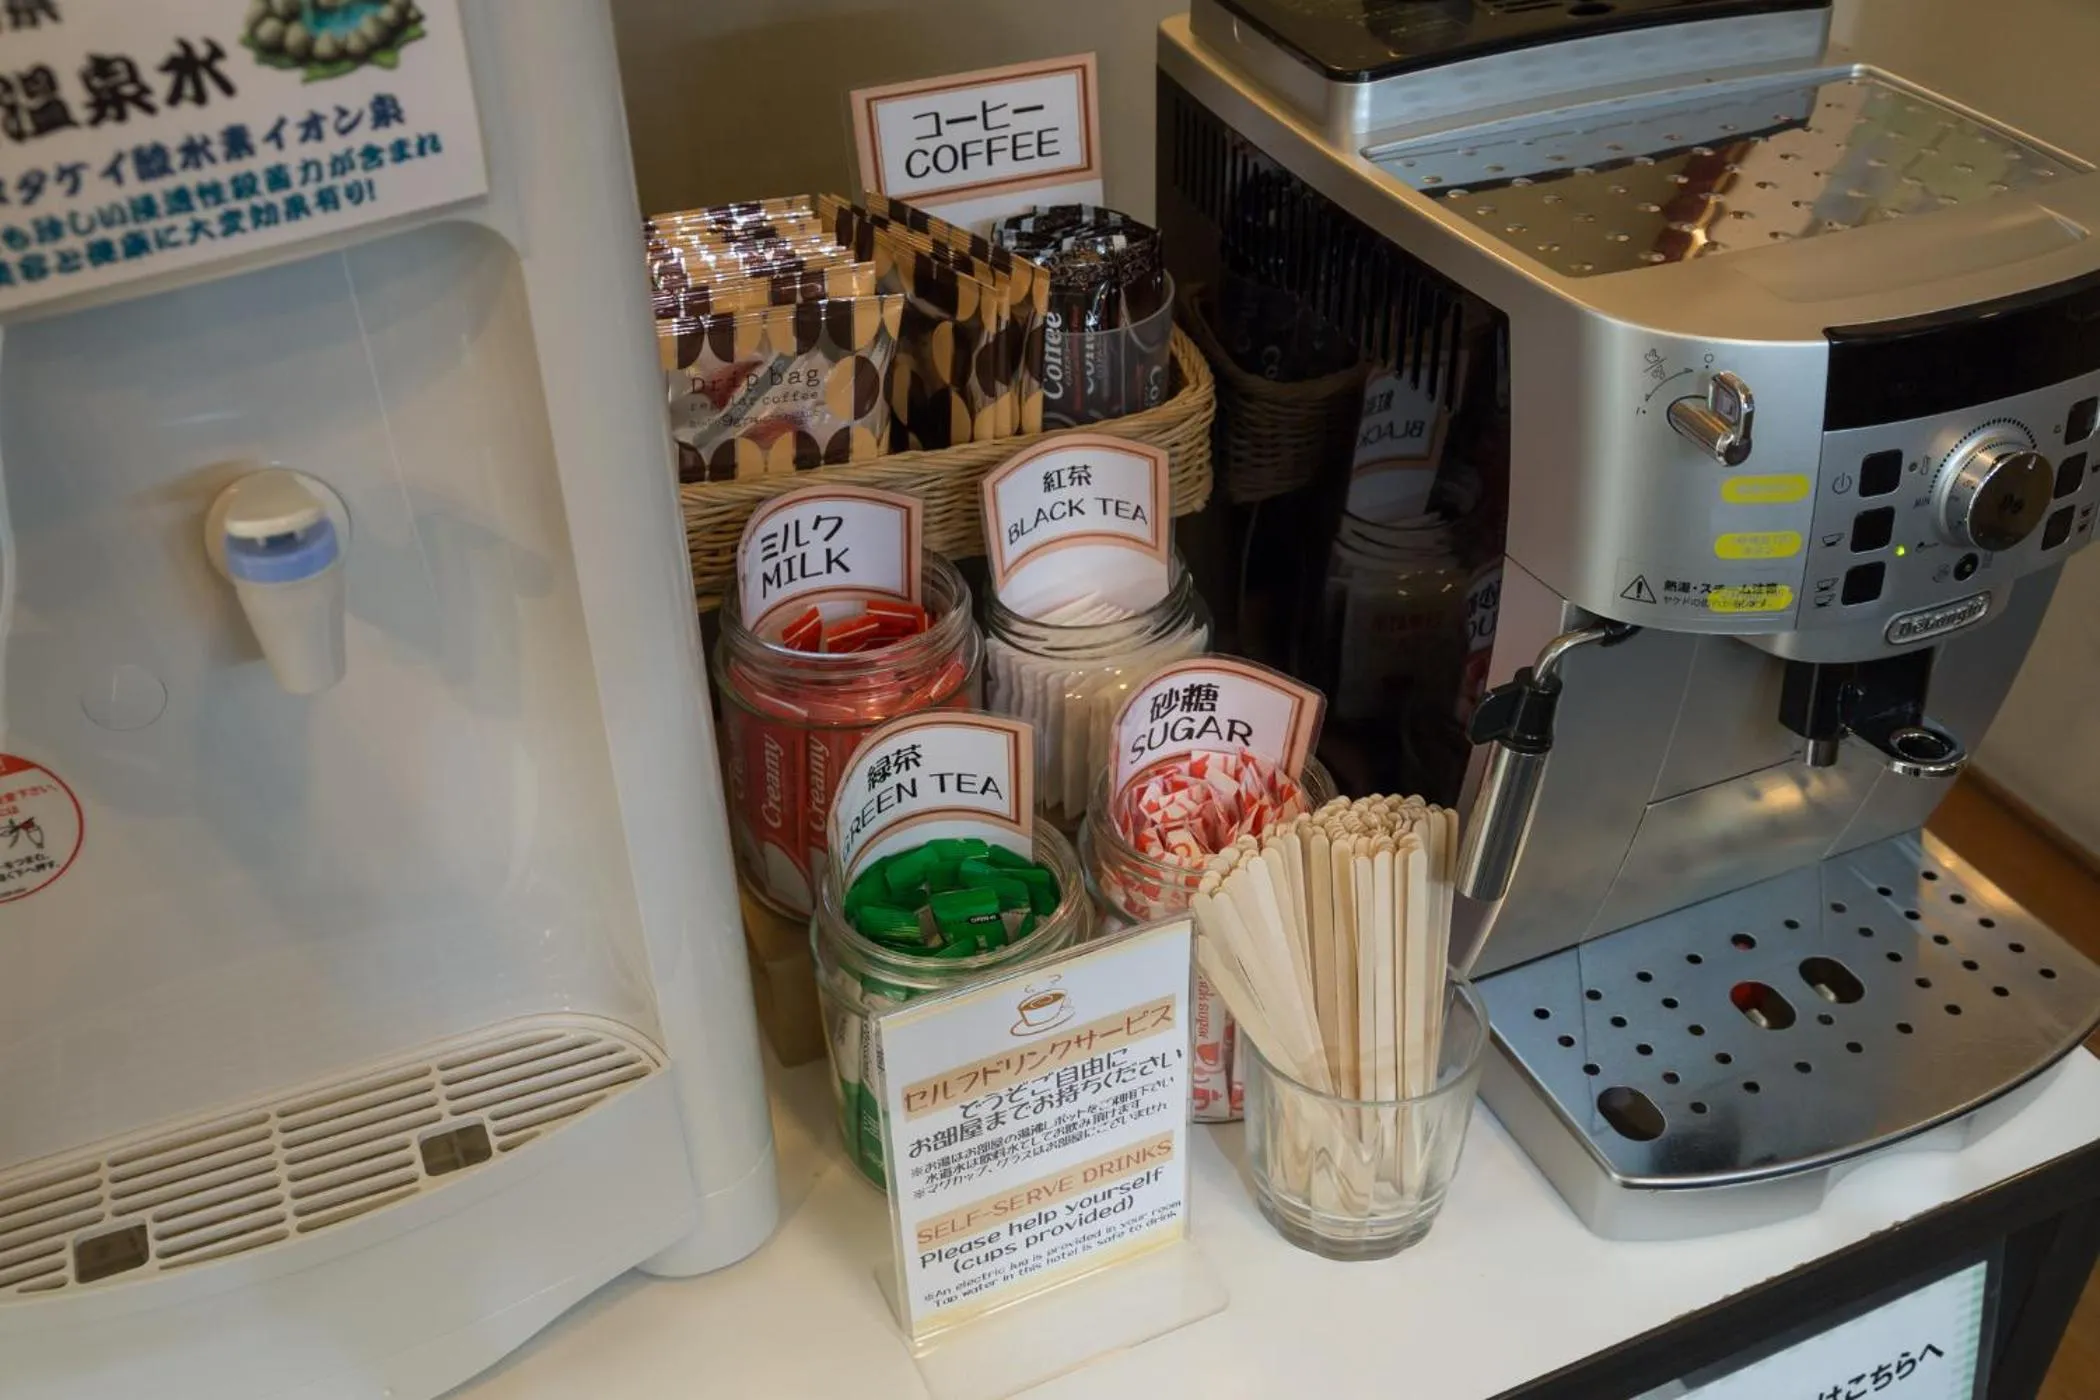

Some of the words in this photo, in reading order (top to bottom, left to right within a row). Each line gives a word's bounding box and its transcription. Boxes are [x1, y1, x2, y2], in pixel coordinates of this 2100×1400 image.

[0, 36, 237, 142] 温泉水
[912, 100, 1044, 140] コーヒー
[905, 127, 1060, 178] COFFEE
[769, 366, 821, 387] bag
[1043, 464, 1092, 493] 紅茶
[761, 515, 843, 563] ミルク
[1008, 499, 1085, 546] BLACK
[1093, 498, 1148, 525] TEA
[762, 547, 850, 598] MILK
[1150, 683, 1219, 723] 砂糖
[1130, 716, 1253, 764] SUGAR
[761, 733, 783, 829] Creamy
[867, 744, 922, 792] 緑茶
[929, 773, 1003, 800] TEA
[905, 1003, 1174, 1114] セルフドリンクサービス
[959, 1048, 1128, 1120] どうぞご自由に
[908, 1048, 1185, 1159] お部屋までお持ちください
[916, 1175, 1074, 1244] SELF-SERVE
[1083, 1138, 1172, 1184] DRINKS
[920, 1229, 1001, 1269] Please
[1008, 1207, 1057, 1236] help
[1065, 1166, 1163, 1216] yourself
[953, 1241, 1019, 1274] (cups
[1025, 1194, 1135, 1249] provided)
[955, 1267, 1005, 1292] electric
[1046, 1230, 1102, 1259] provided
[1120, 1211, 1148, 1229] your
[1151, 1200, 1181, 1217] room
[962, 1278, 998, 1297] water
[1018, 1262, 1043, 1277] this
[1046, 1247, 1078, 1267] hotel
[1097, 1230, 1125, 1246] safe
[1145, 1209, 1177, 1228] drink
